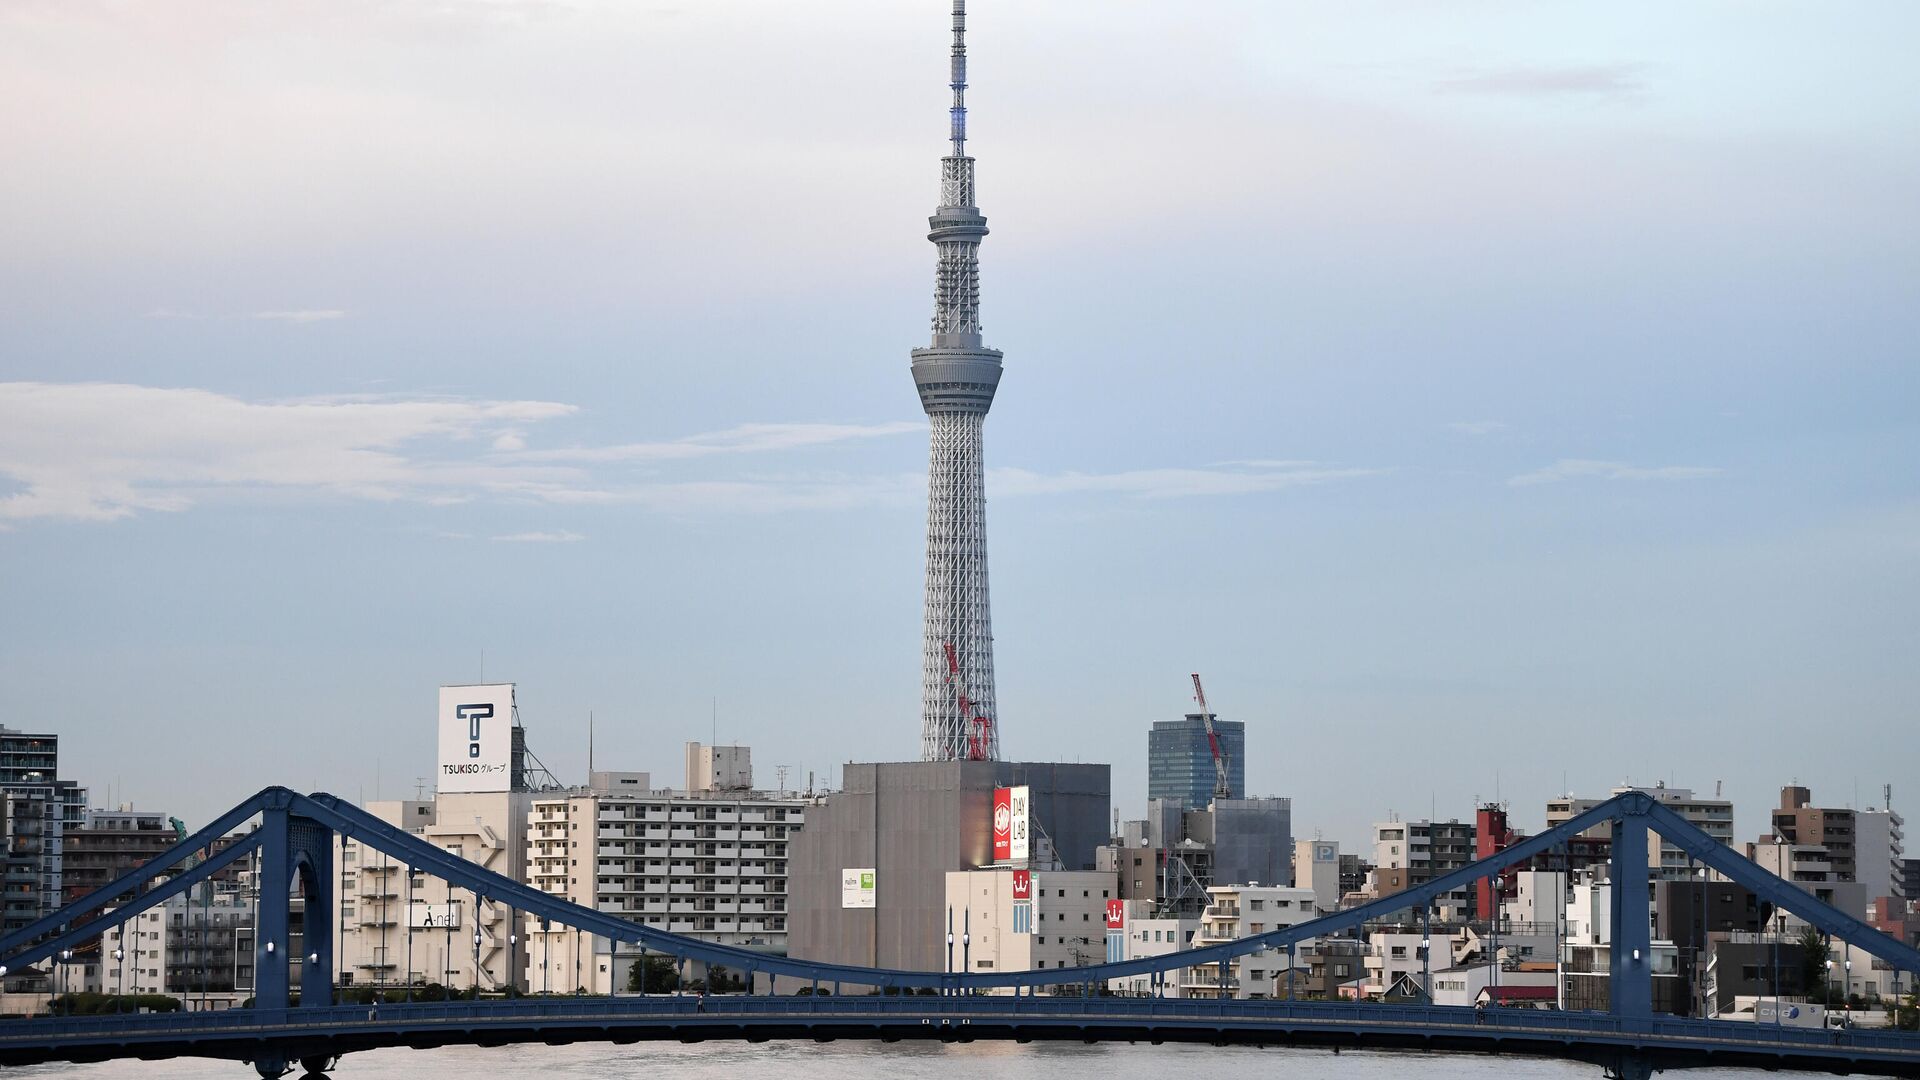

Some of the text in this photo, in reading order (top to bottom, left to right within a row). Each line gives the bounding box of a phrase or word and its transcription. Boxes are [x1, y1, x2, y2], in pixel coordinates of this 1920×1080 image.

[443, 764, 480, 774] TSUKISO
[1013, 797, 1026, 816] DAY
[1013, 820, 1026, 840] LAB
[1319, 846, 1331, 860] P
